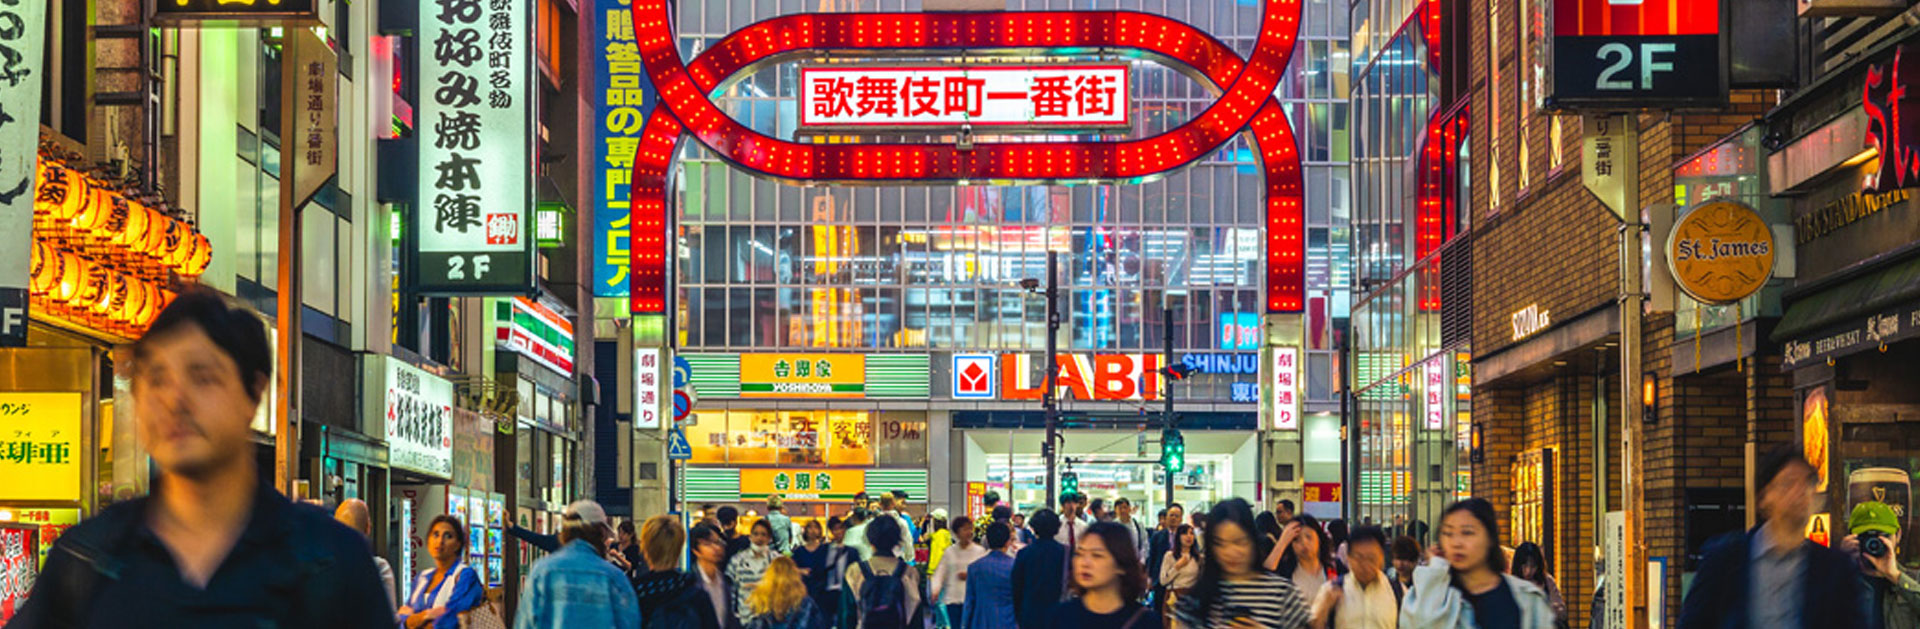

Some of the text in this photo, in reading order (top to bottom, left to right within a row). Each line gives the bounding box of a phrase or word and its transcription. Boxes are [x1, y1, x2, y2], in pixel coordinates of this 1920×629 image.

[812, 75, 1118, 118] 歌舞伎町一番街
[1596, 42, 1677, 91] 2F
[306, 61, 325, 167] 劇場通り一番街
[433, 0, 483, 234] お好み焼本陣
[605, 0, 643, 288] 贈答品の専門フロア
[1595, 115, 1612, 177] り一番街
[447, 254, 491, 280] 2F
[641, 353, 656, 423] 劇場通り
[1002, 353, 1164, 400] LABI
[1278, 353, 1293, 423] 劇場通り
